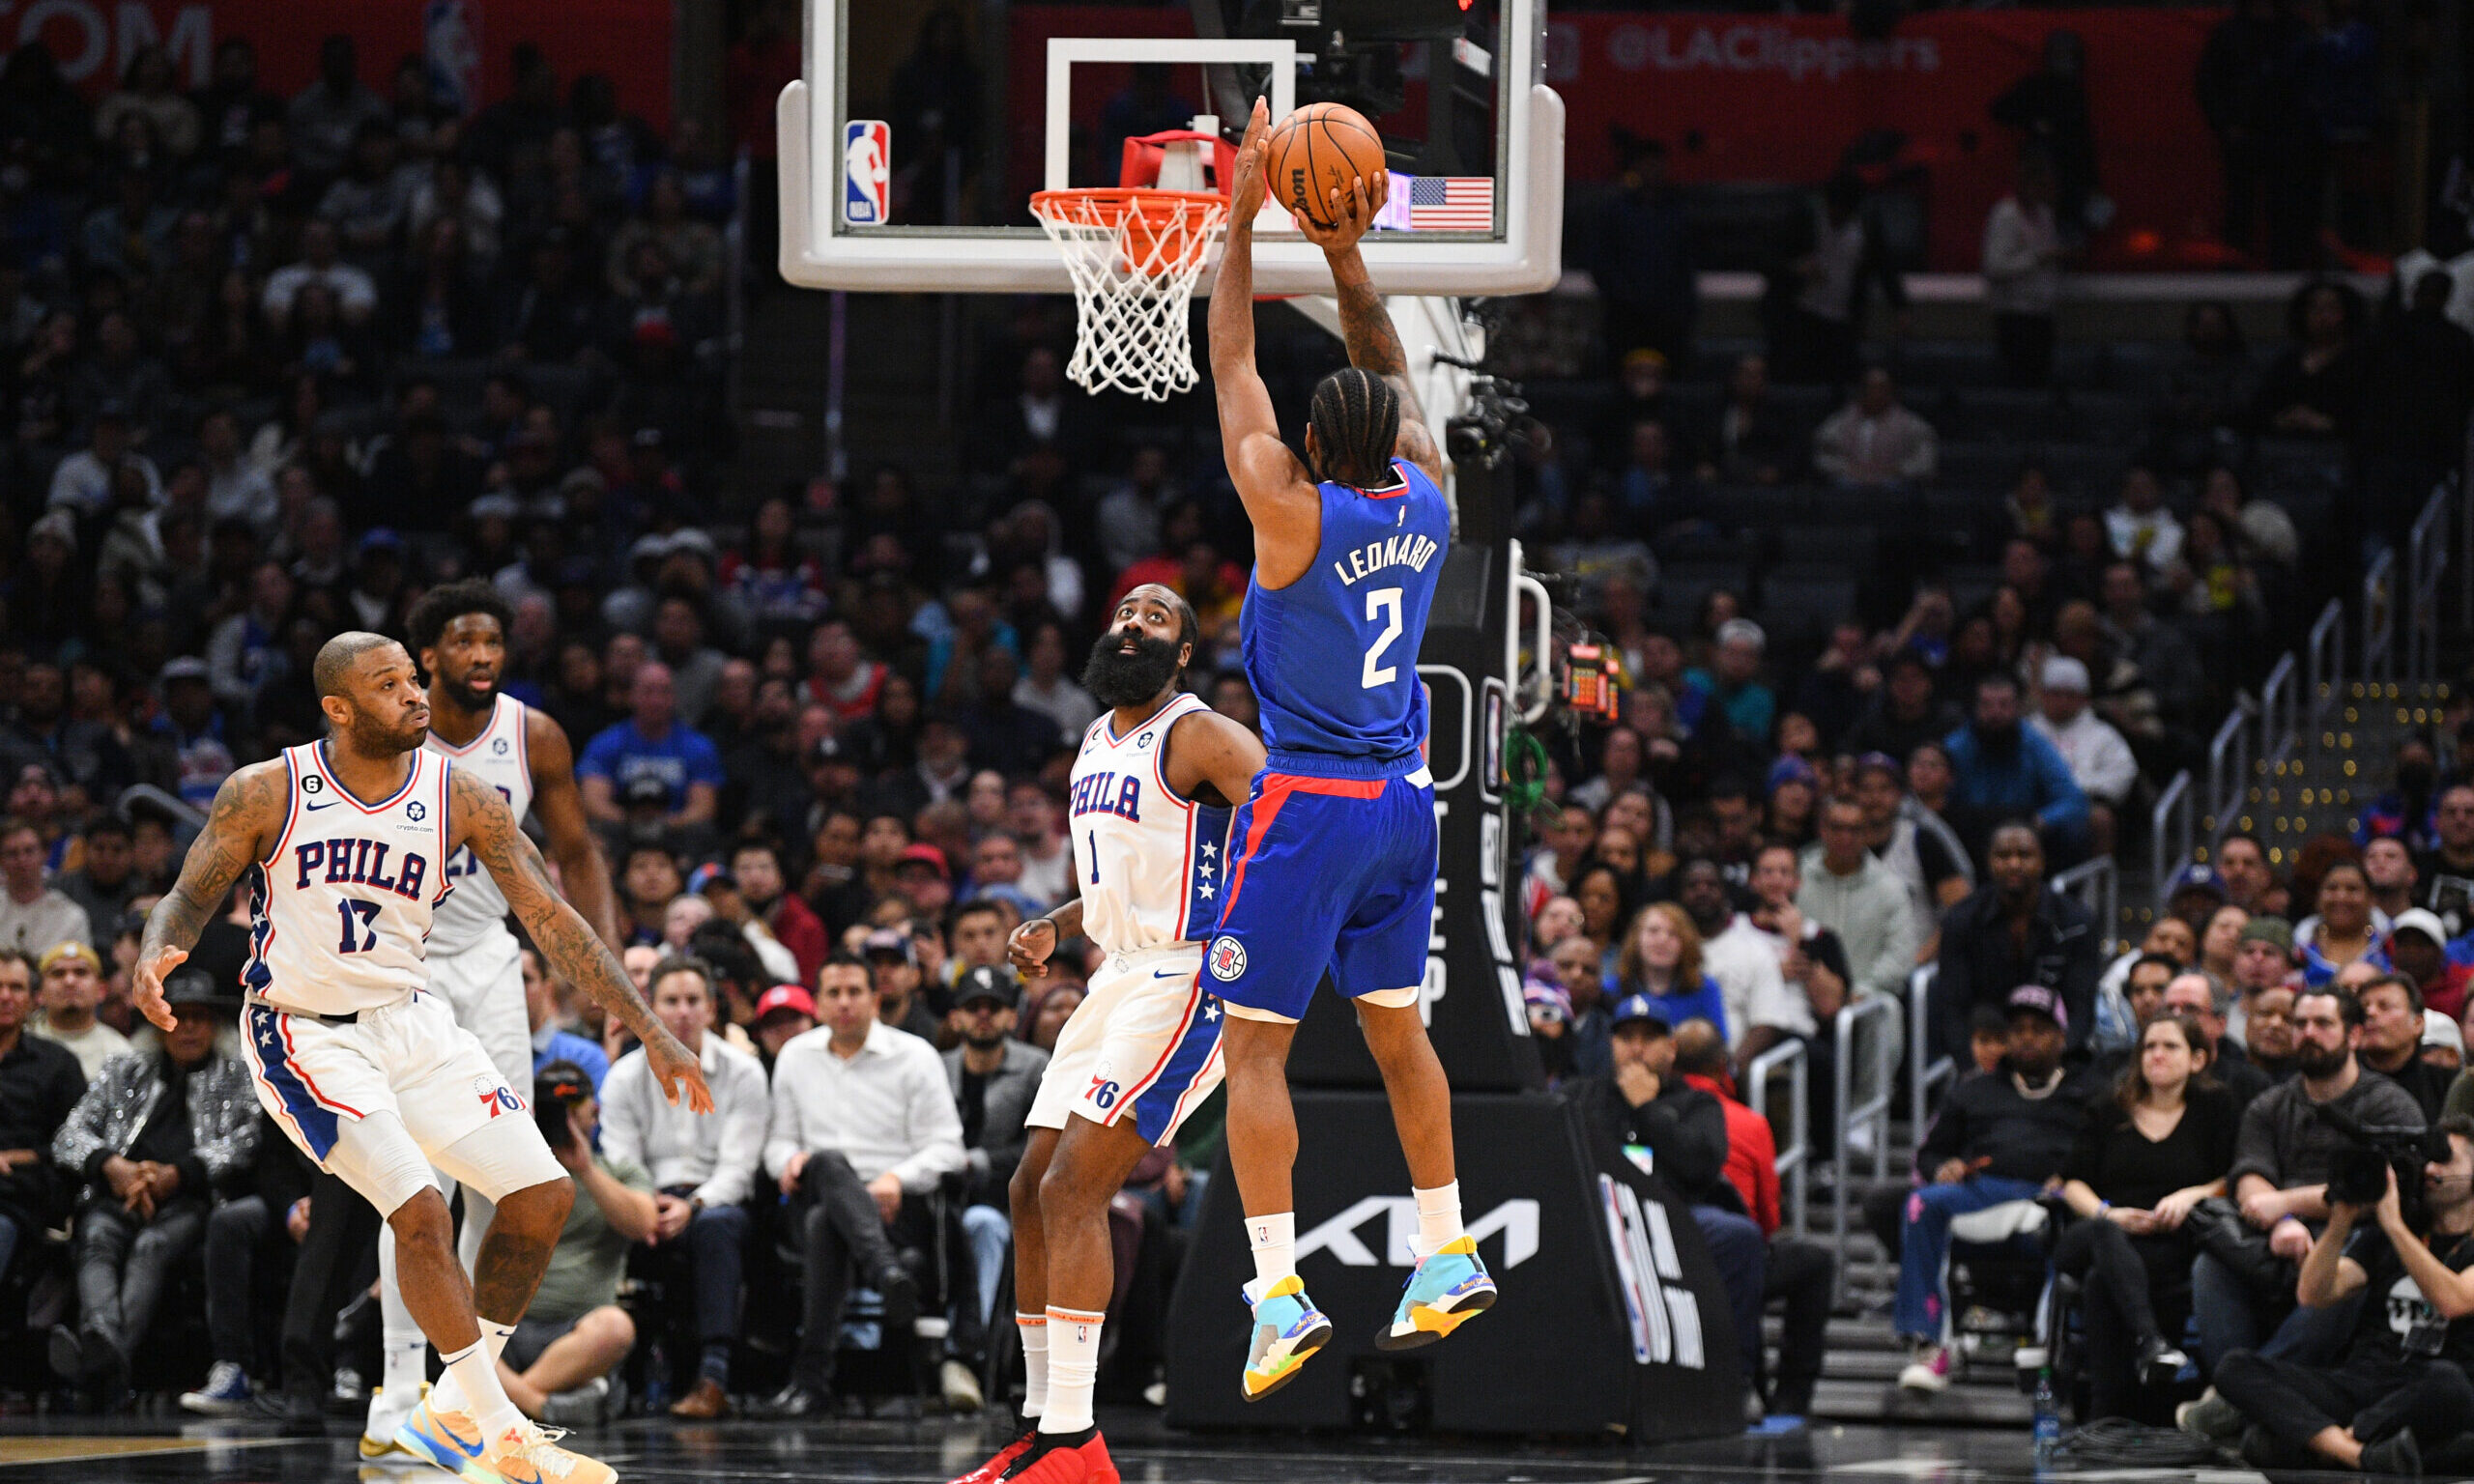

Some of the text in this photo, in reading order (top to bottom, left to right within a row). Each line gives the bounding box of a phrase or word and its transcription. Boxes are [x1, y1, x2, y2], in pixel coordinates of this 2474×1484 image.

[0, 0, 212, 87] OM
[1334, 533, 1438, 586] LEONARD
[1362, 587, 1403, 689] 2
[304, 776, 320, 793] 6
[1070, 772, 1141, 824] PHILA
[395, 824, 434, 834] crypto.com
[295, 838, 427, 901] PHILA
[1088, 829, 1100, 885] 1
[338, 898, 383, 955] 17
[1084, 1073, 1120, 1109] 76
